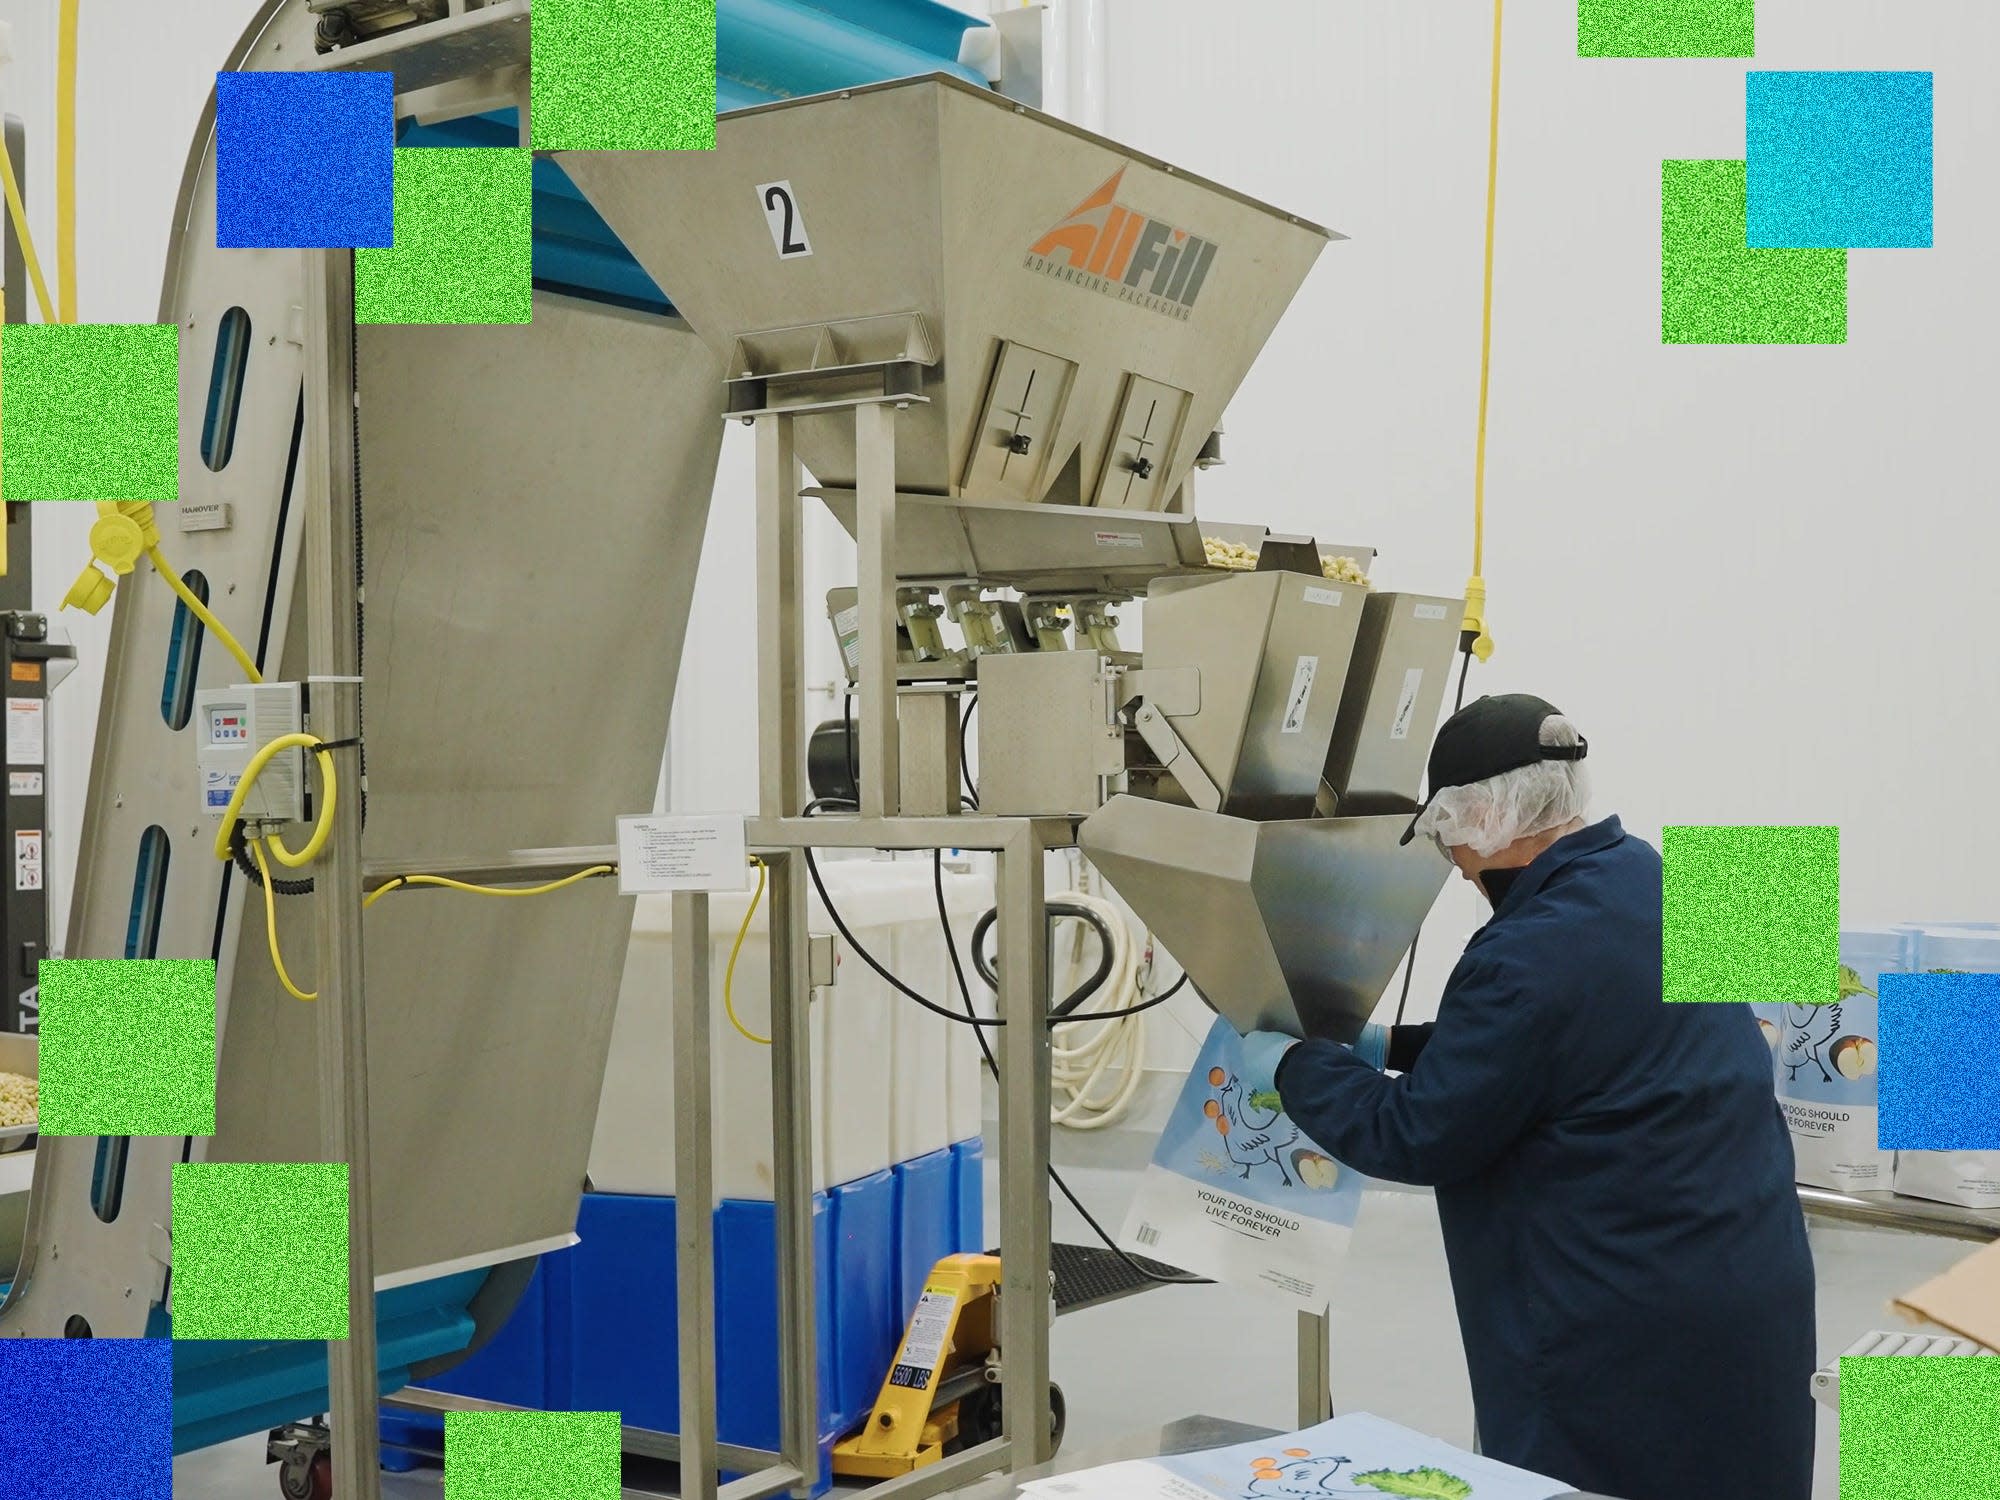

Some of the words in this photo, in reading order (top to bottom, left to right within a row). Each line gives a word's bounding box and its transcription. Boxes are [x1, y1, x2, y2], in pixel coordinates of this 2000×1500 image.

[765, 186, 807, 254] 2
[1025, 256, 1109, 292] ADVANCING
[1119, 288, 1190, 321] PACKAGING
[181, 505, 219, 513] HANOVER
[1789, 1105, 1806, 1117] DOG
[1808, 1109, 1850, 1122] SHOULD
[1794, 1118, 1835, 1132] FOREVER
[1197, 1189, 1227, 1206] YOUR
[1228, 1201, 1253, 1216] DOG
[1254, 1209, 1300, 1231] SHOULD
[1205, 1205, 1229, 1220] LIVE
[1231, 1213, 1281, 1237] FOREVER
[913, 1369, 929, 1389] LBS
